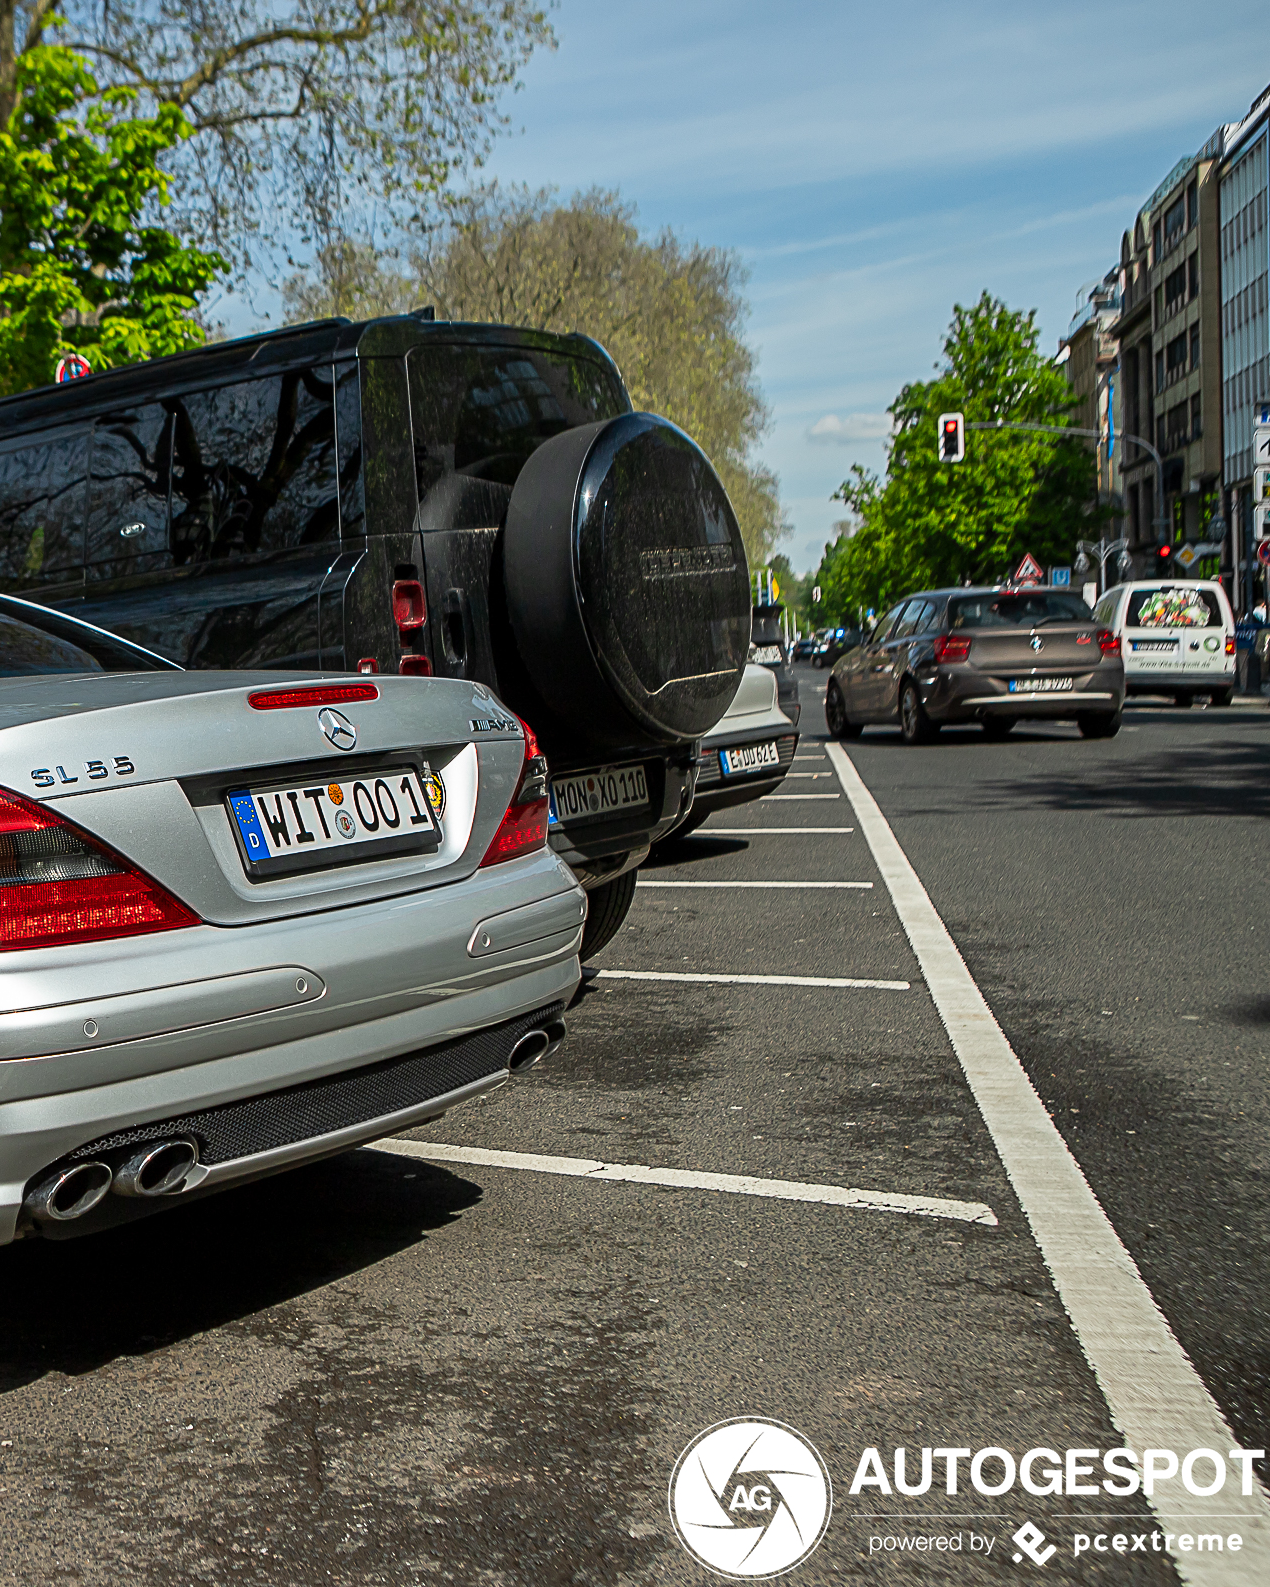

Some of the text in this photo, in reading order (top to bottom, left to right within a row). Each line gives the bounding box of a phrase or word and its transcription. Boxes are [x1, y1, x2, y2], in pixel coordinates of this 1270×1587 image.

[31, 755, 135, 787] SL 55
[555, 780, 589, 817] MON
[619, 769, 646, 803] 110
[257, 788, 331, 847] WIT
[248, 832, 260, 848] D
